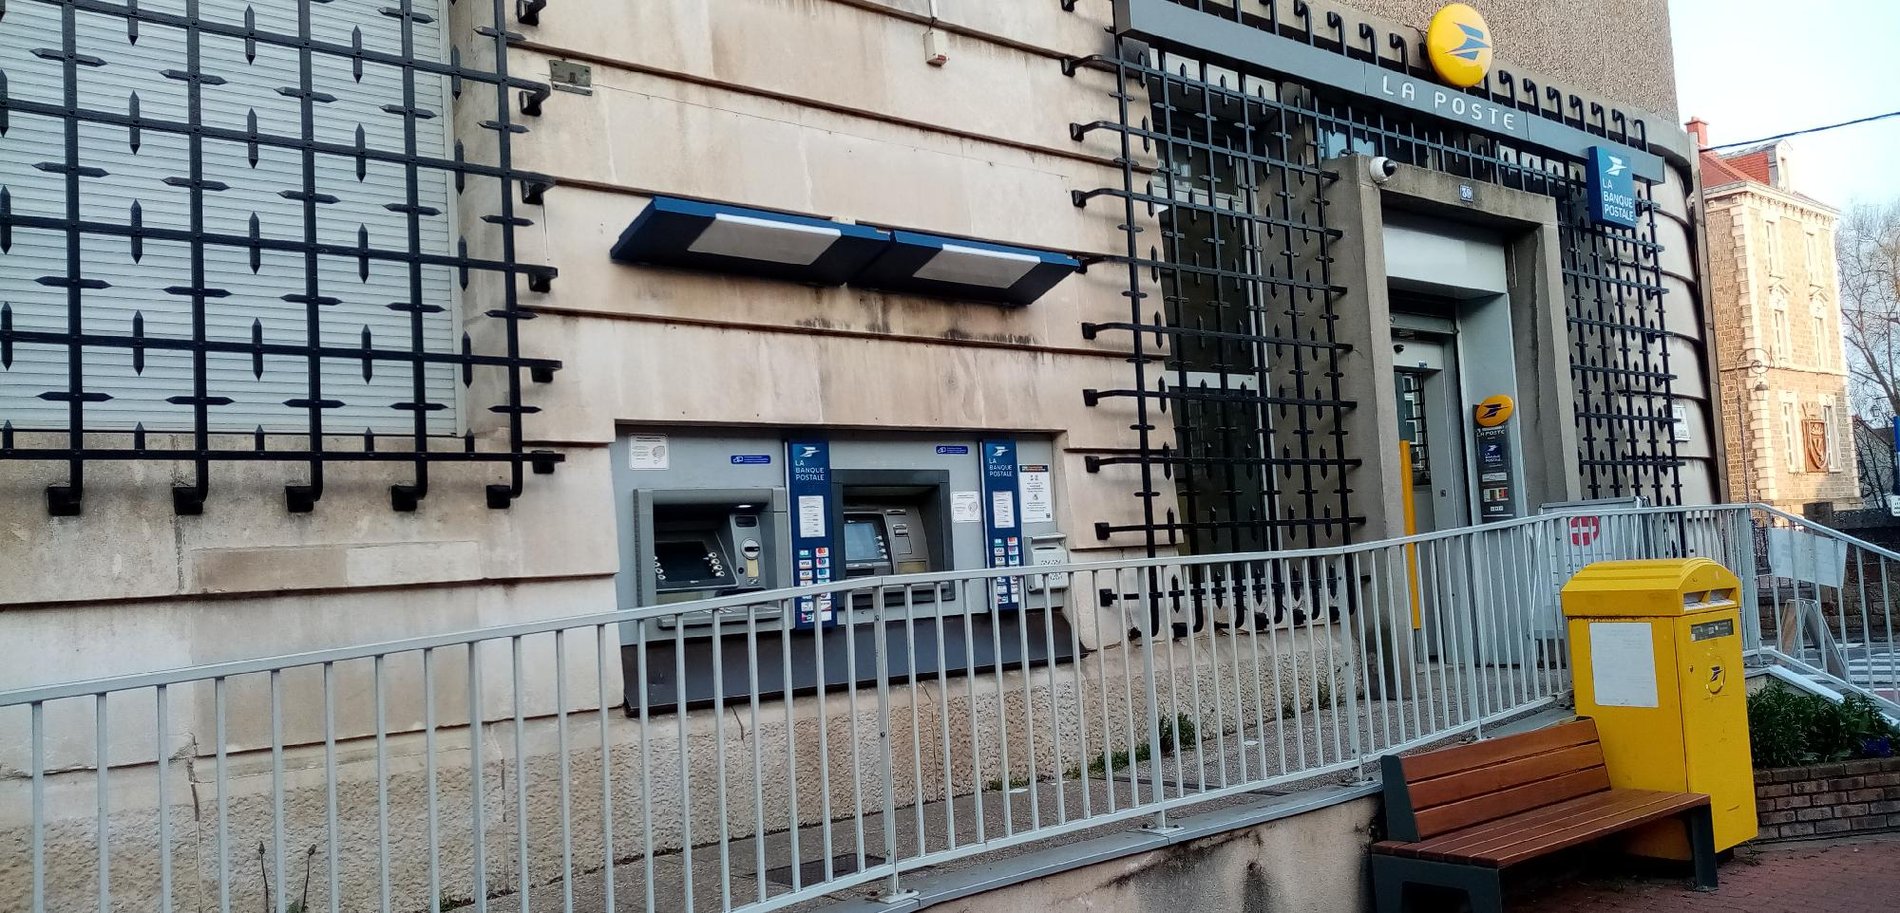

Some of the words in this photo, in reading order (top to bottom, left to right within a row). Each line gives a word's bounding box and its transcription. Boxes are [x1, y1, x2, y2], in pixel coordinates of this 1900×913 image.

[1382, 75, 1415, 102] LA
[1434, 90, 1515, 131] POSTE
[1602, 178, 1613, 190] LA
[1603, 190, 1633, 209] BANQUE
[1604, 203, 1634, 221] POSTALE
[795, 459, 805, 467] LA
